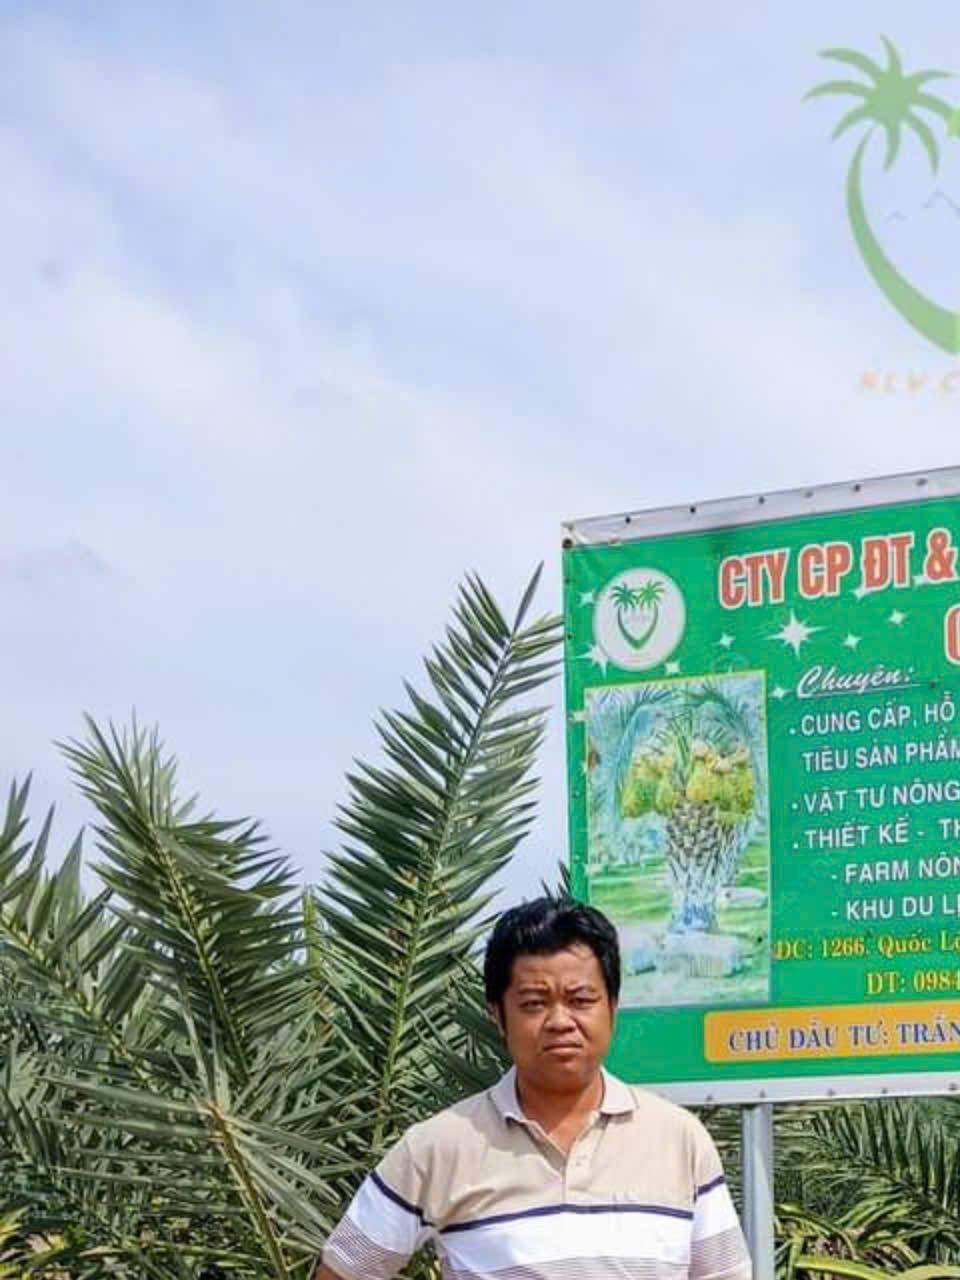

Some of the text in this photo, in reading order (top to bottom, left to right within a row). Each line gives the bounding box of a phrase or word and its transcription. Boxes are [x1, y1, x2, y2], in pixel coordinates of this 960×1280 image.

[718, 551, 789, 609] CTY
[799, 542, 852, 601] CP
[861, 531, 915, 590] ĐT
[922, 527, 958, 584] &
[797, 664, 915, 698] Chuyên:
[801, 710, 861, 735] CUNG
[856, 784, 887, 809] TƯ
[893, 778, 960, 806] NÔNG
[804, 816, 869, 849] THIẾT
[879, 812, 910, 845] KẾ
[846, 897, 894, 920] KHU
[903, 895, 933, 917] DU
